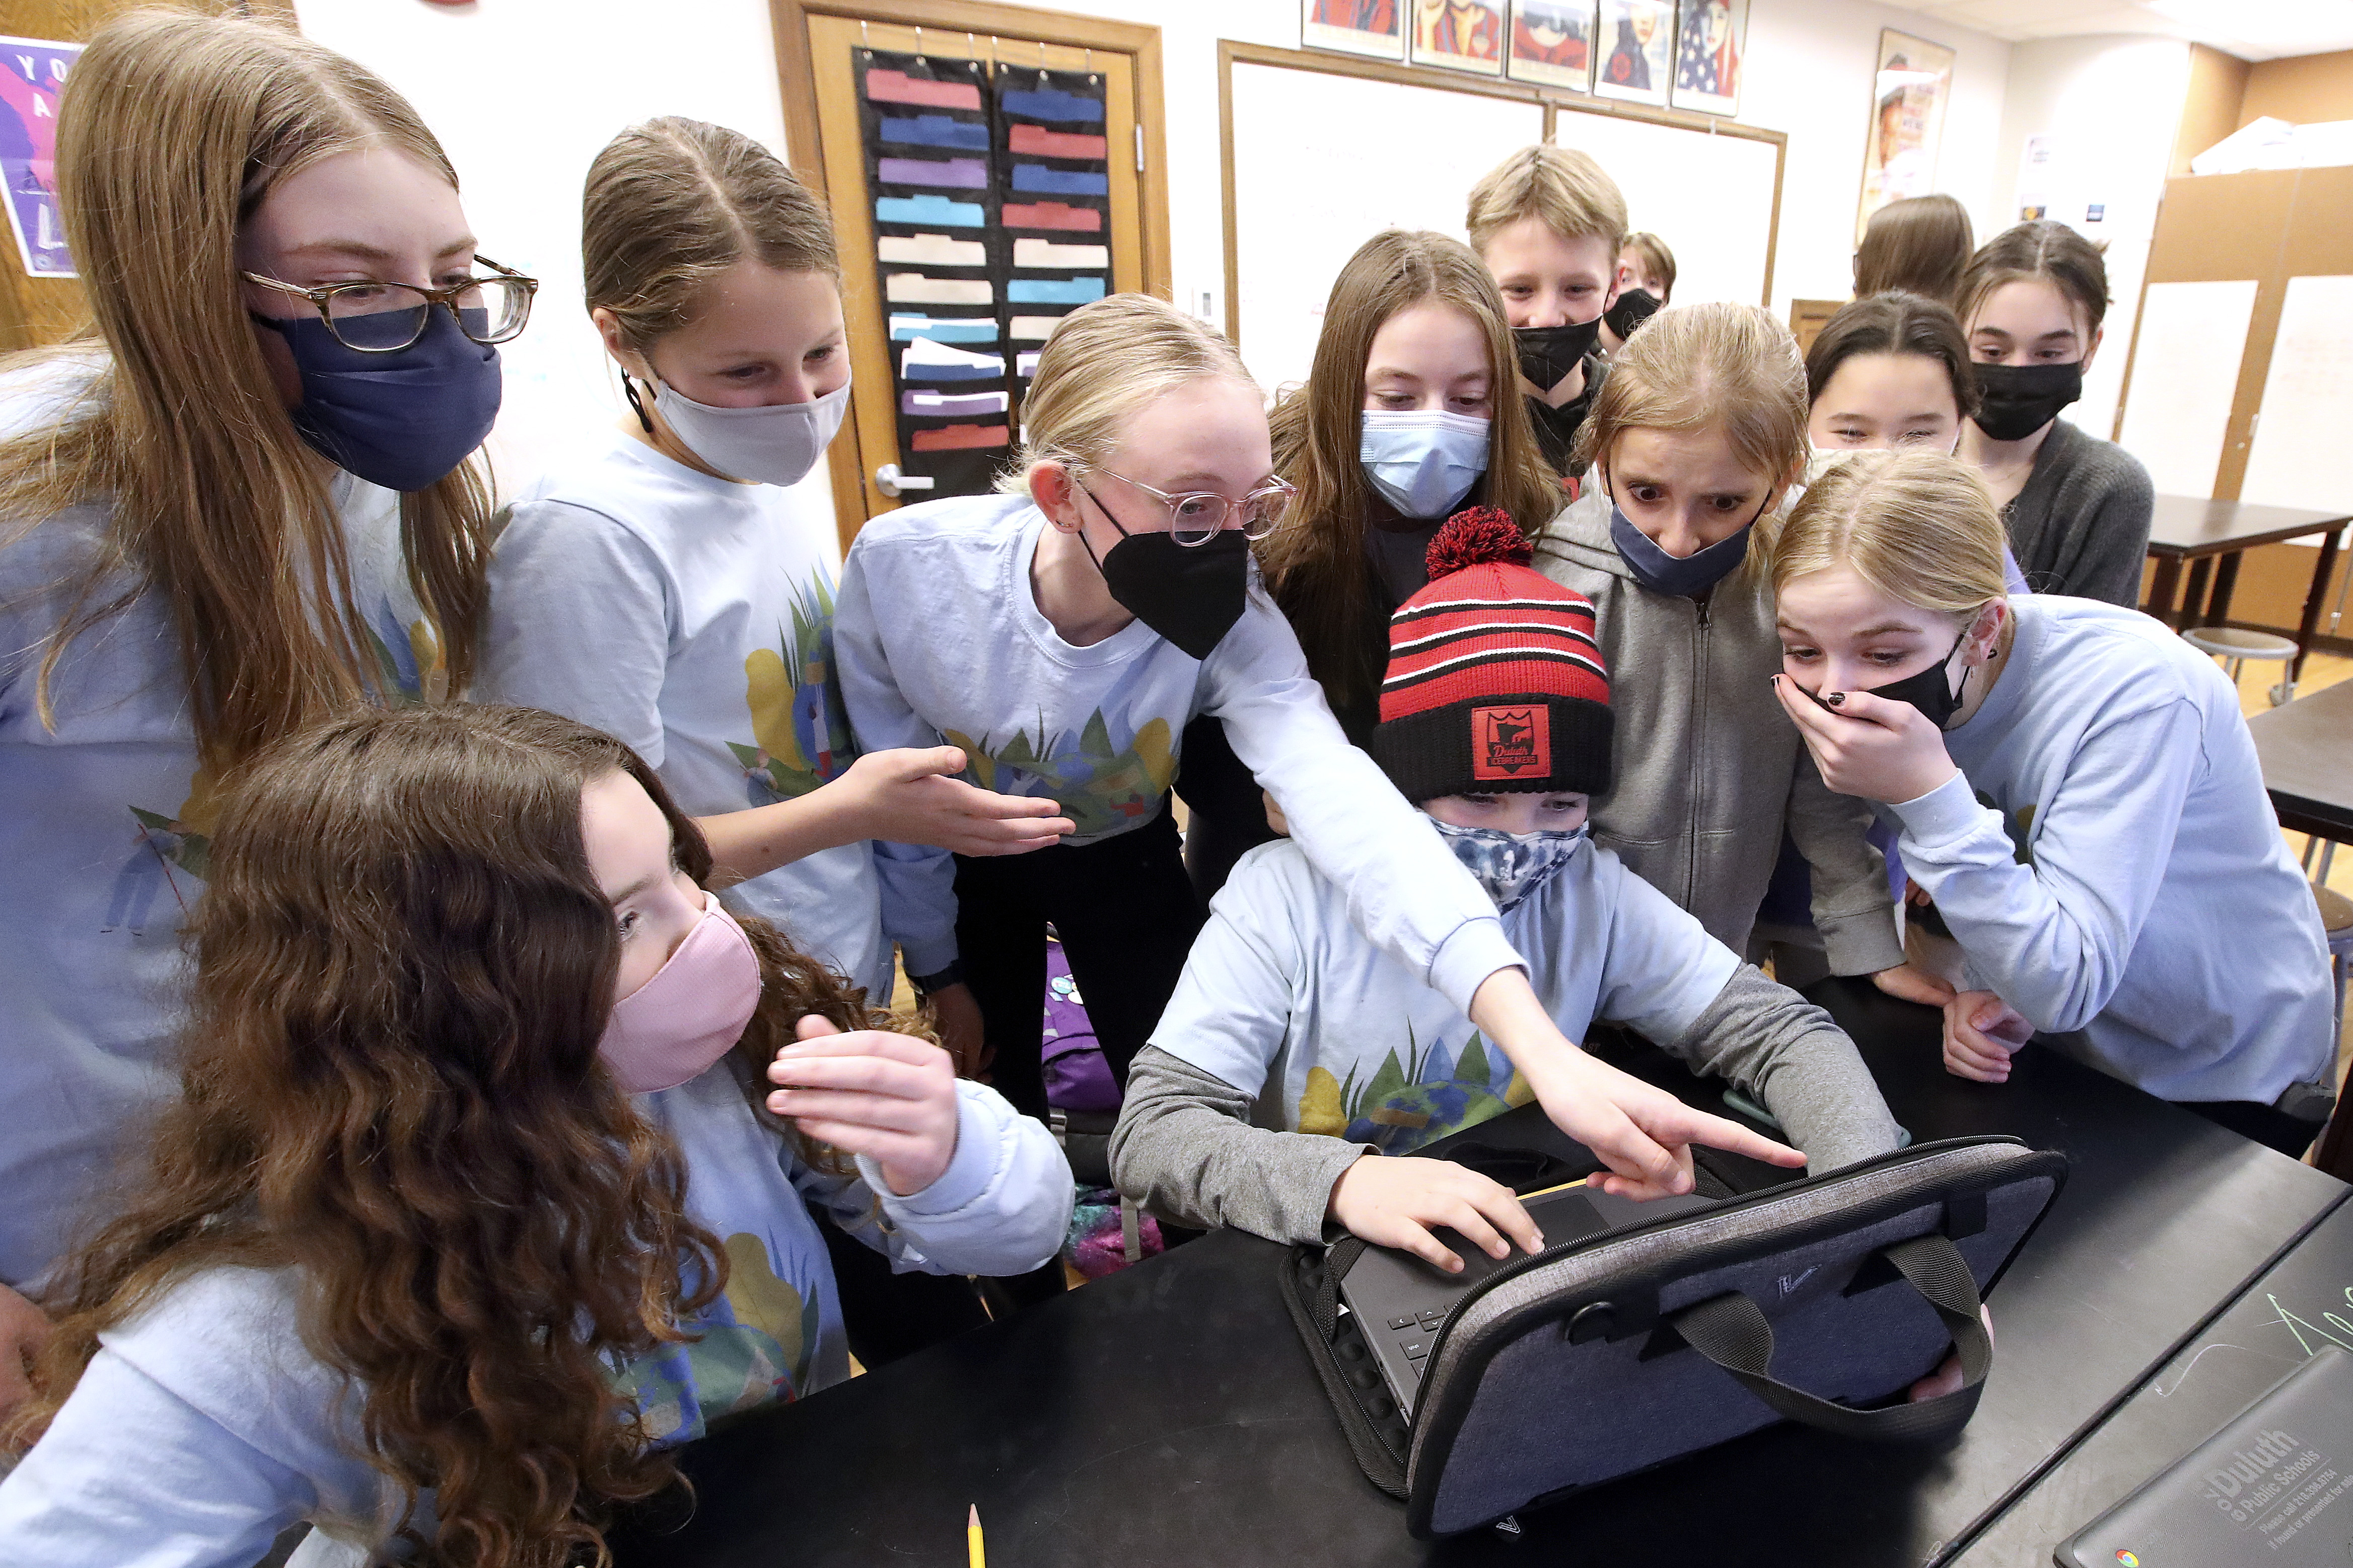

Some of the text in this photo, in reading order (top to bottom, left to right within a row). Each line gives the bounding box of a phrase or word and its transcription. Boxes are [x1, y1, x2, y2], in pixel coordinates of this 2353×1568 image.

[1493, 745, 1528, 757] Duluth
[2203, 1430, 2299, 1498] Duluth
[2240, 1450, 2321, 1513] Public Schools
[2273, 1524, 2297, 1545] found
